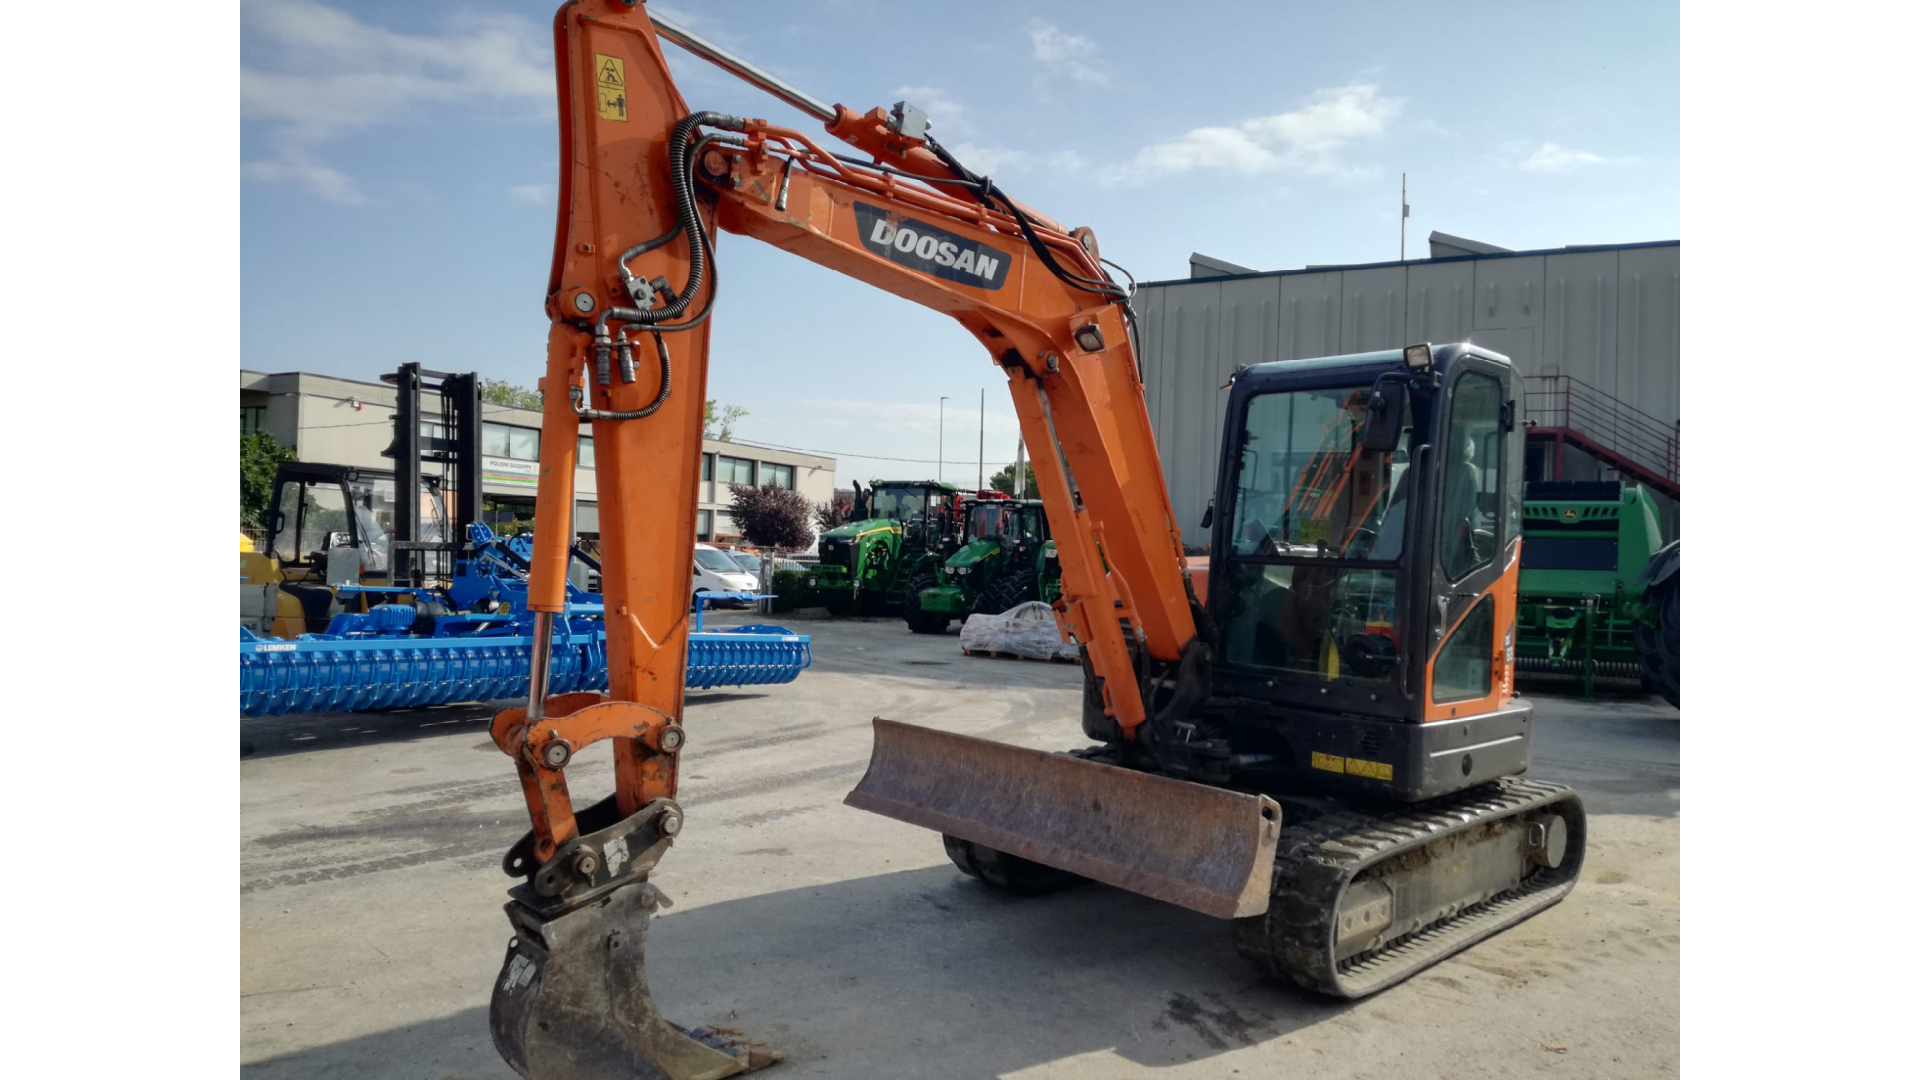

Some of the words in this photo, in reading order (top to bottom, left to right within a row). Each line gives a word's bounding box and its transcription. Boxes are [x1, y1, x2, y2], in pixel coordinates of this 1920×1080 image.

[870, 219, 999, 281] DOOSAN
[490, 460, 510, 468] POLONI
[263, 643, 297, 651] LEMKEN
